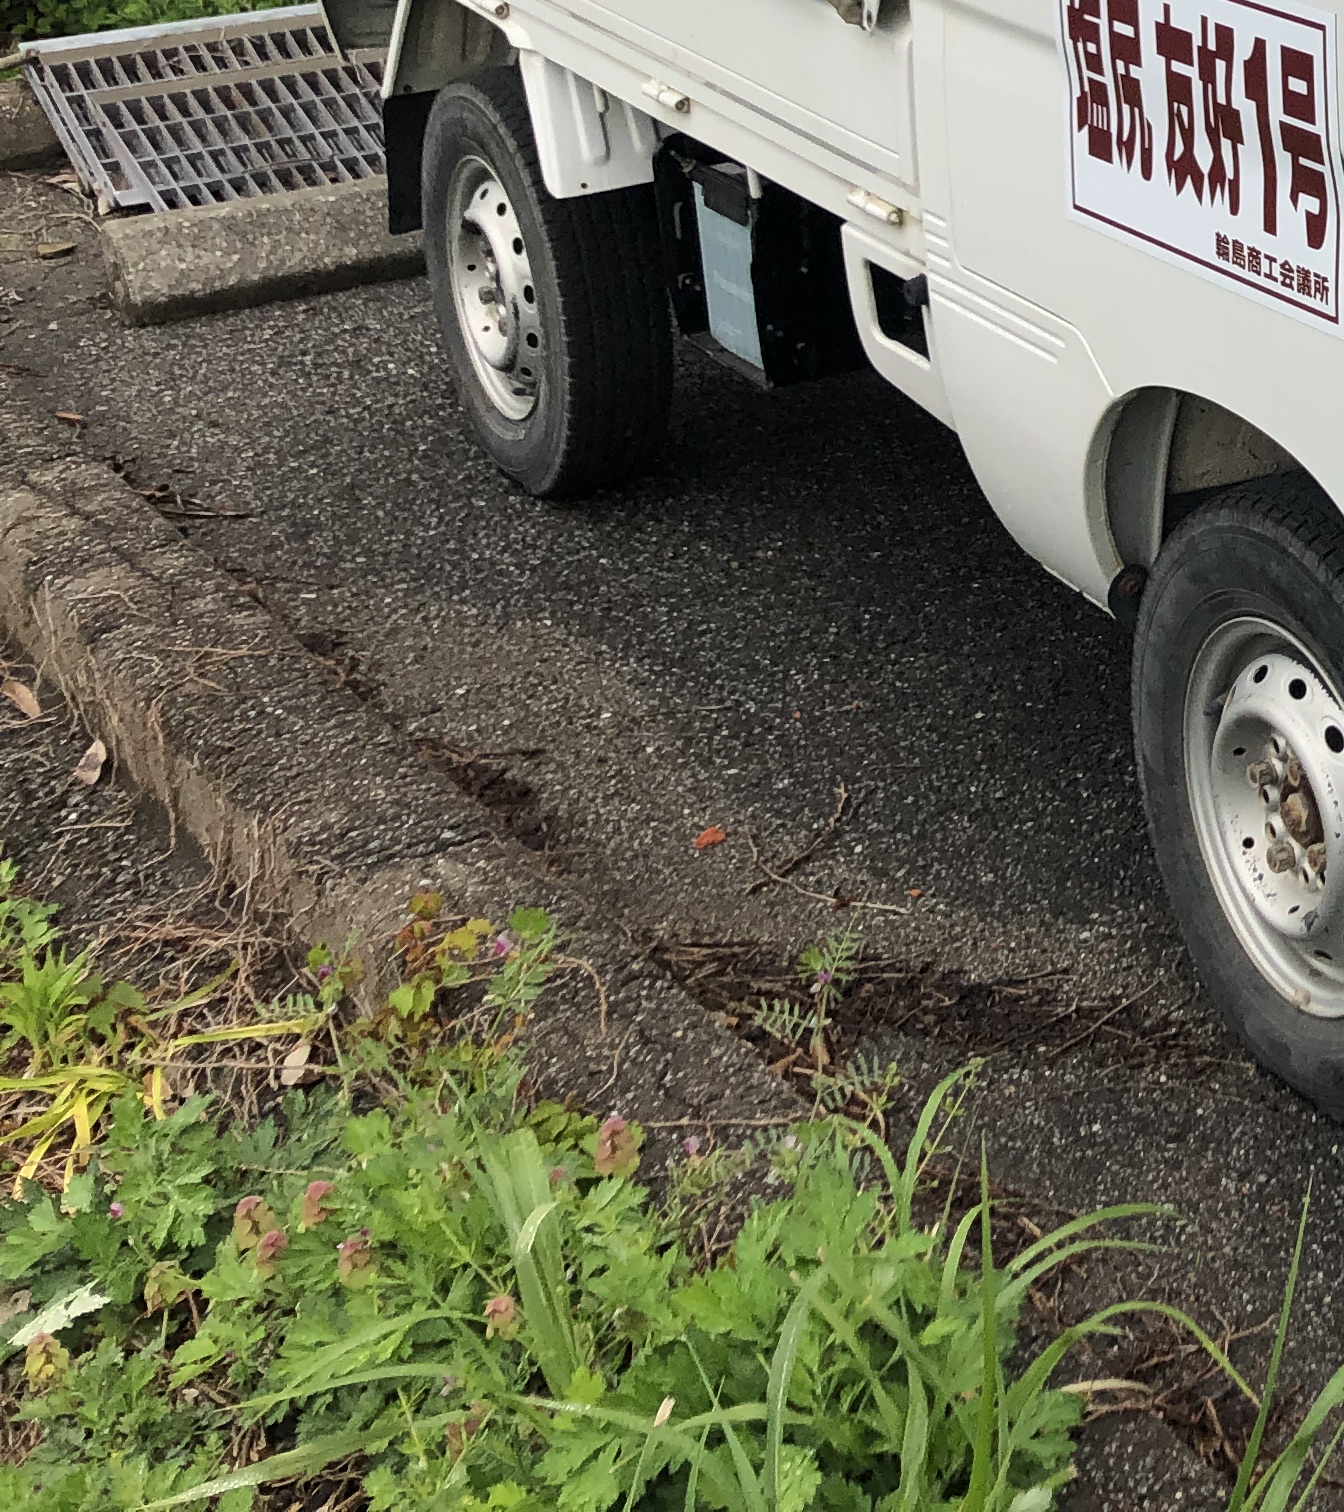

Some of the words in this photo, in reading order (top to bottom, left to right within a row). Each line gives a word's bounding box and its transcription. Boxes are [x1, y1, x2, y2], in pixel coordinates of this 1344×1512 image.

[1215, 231, 1330, 306] 輪島商工会議所
